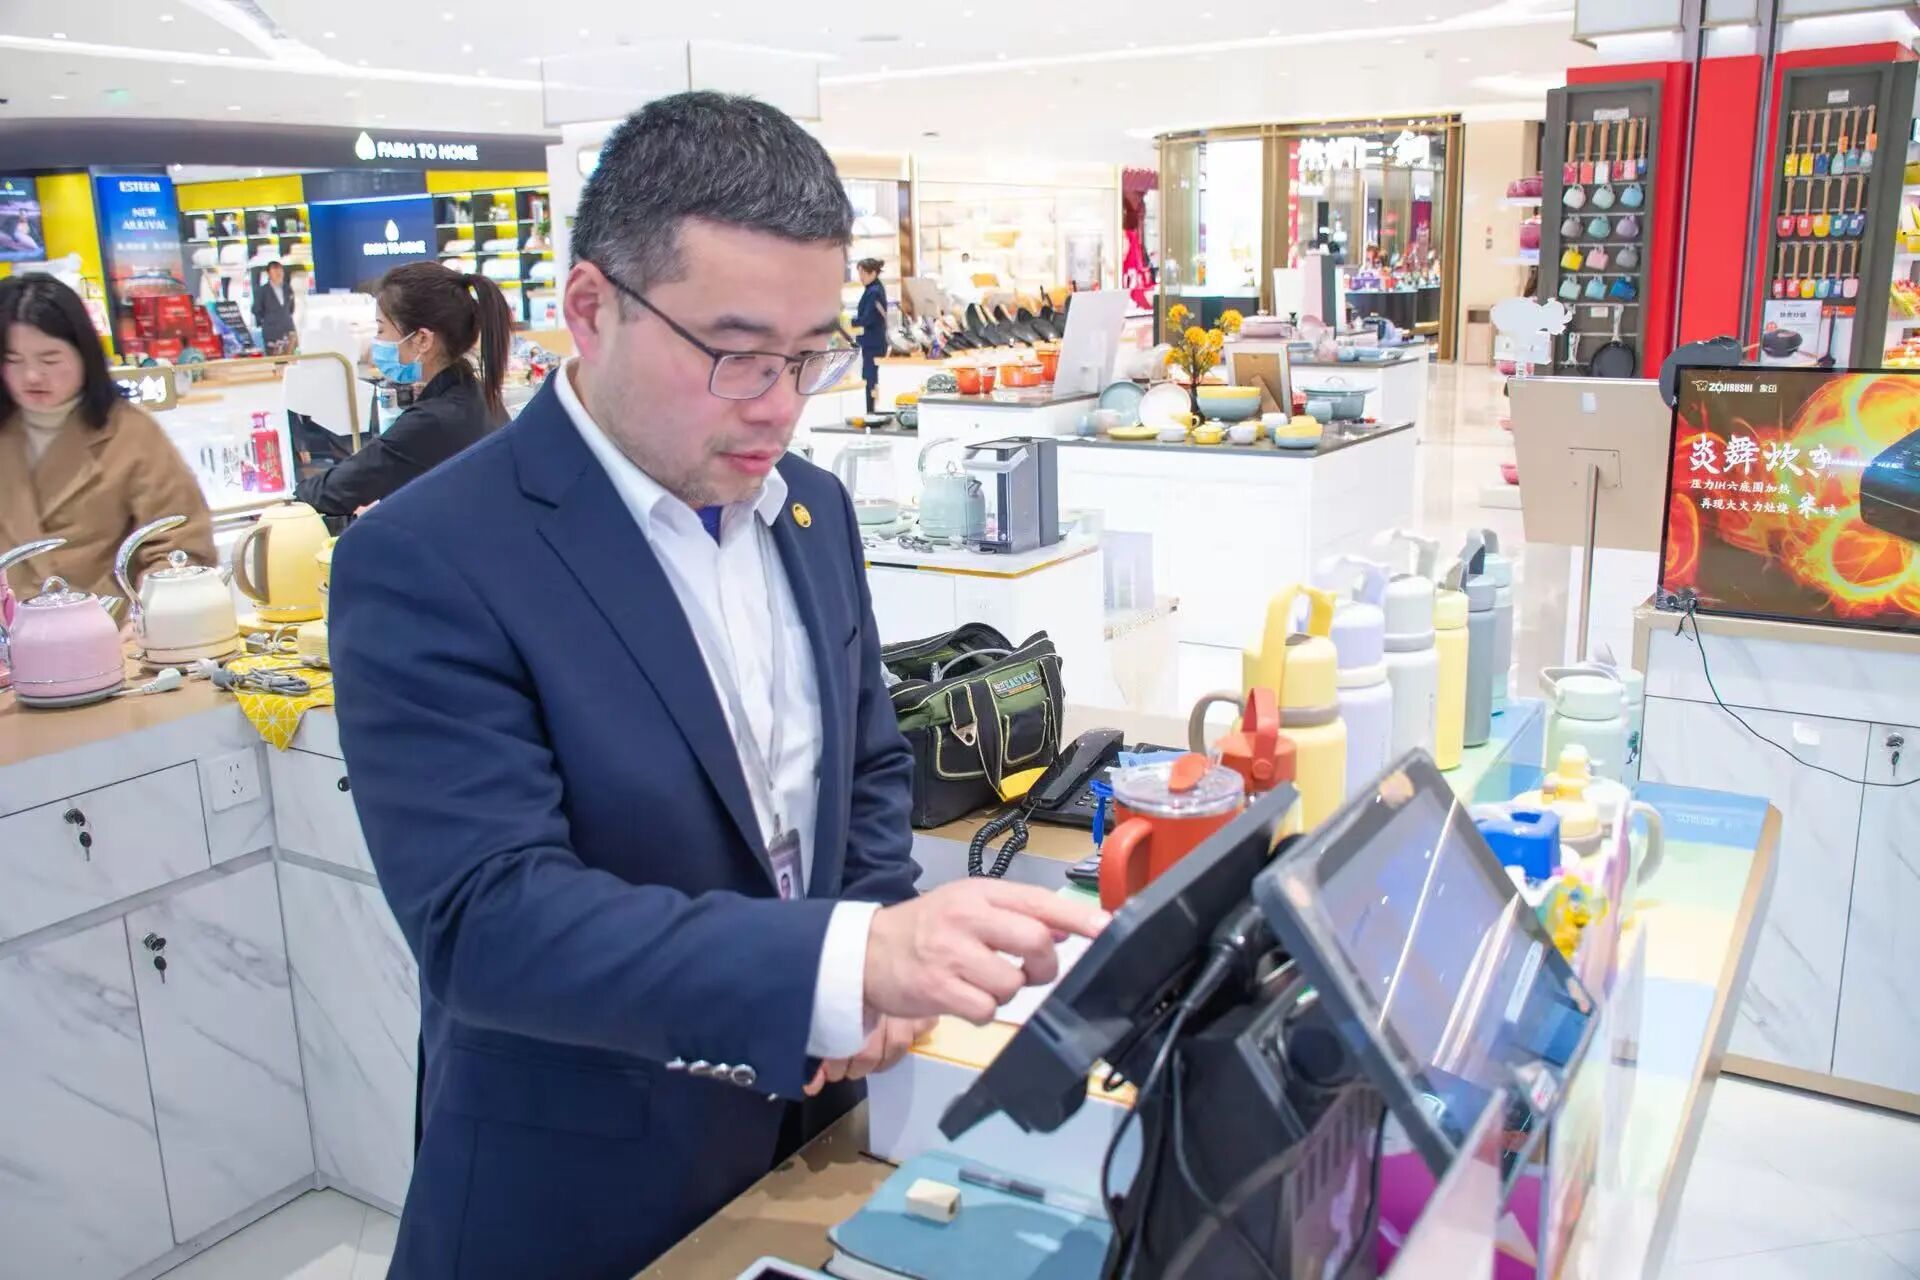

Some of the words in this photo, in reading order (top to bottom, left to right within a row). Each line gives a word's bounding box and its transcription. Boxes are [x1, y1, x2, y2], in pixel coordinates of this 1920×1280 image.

[377, 141, 416, 159] FARM
[417, 143, 437, 159] TO
[438, 144, 478, 160] HOME
[132, 207, 157, 217] NEW
[122, 220, 167, 231] ARRIVAL
[1708, 380, 1753, 394] ZOJIRUSHI
